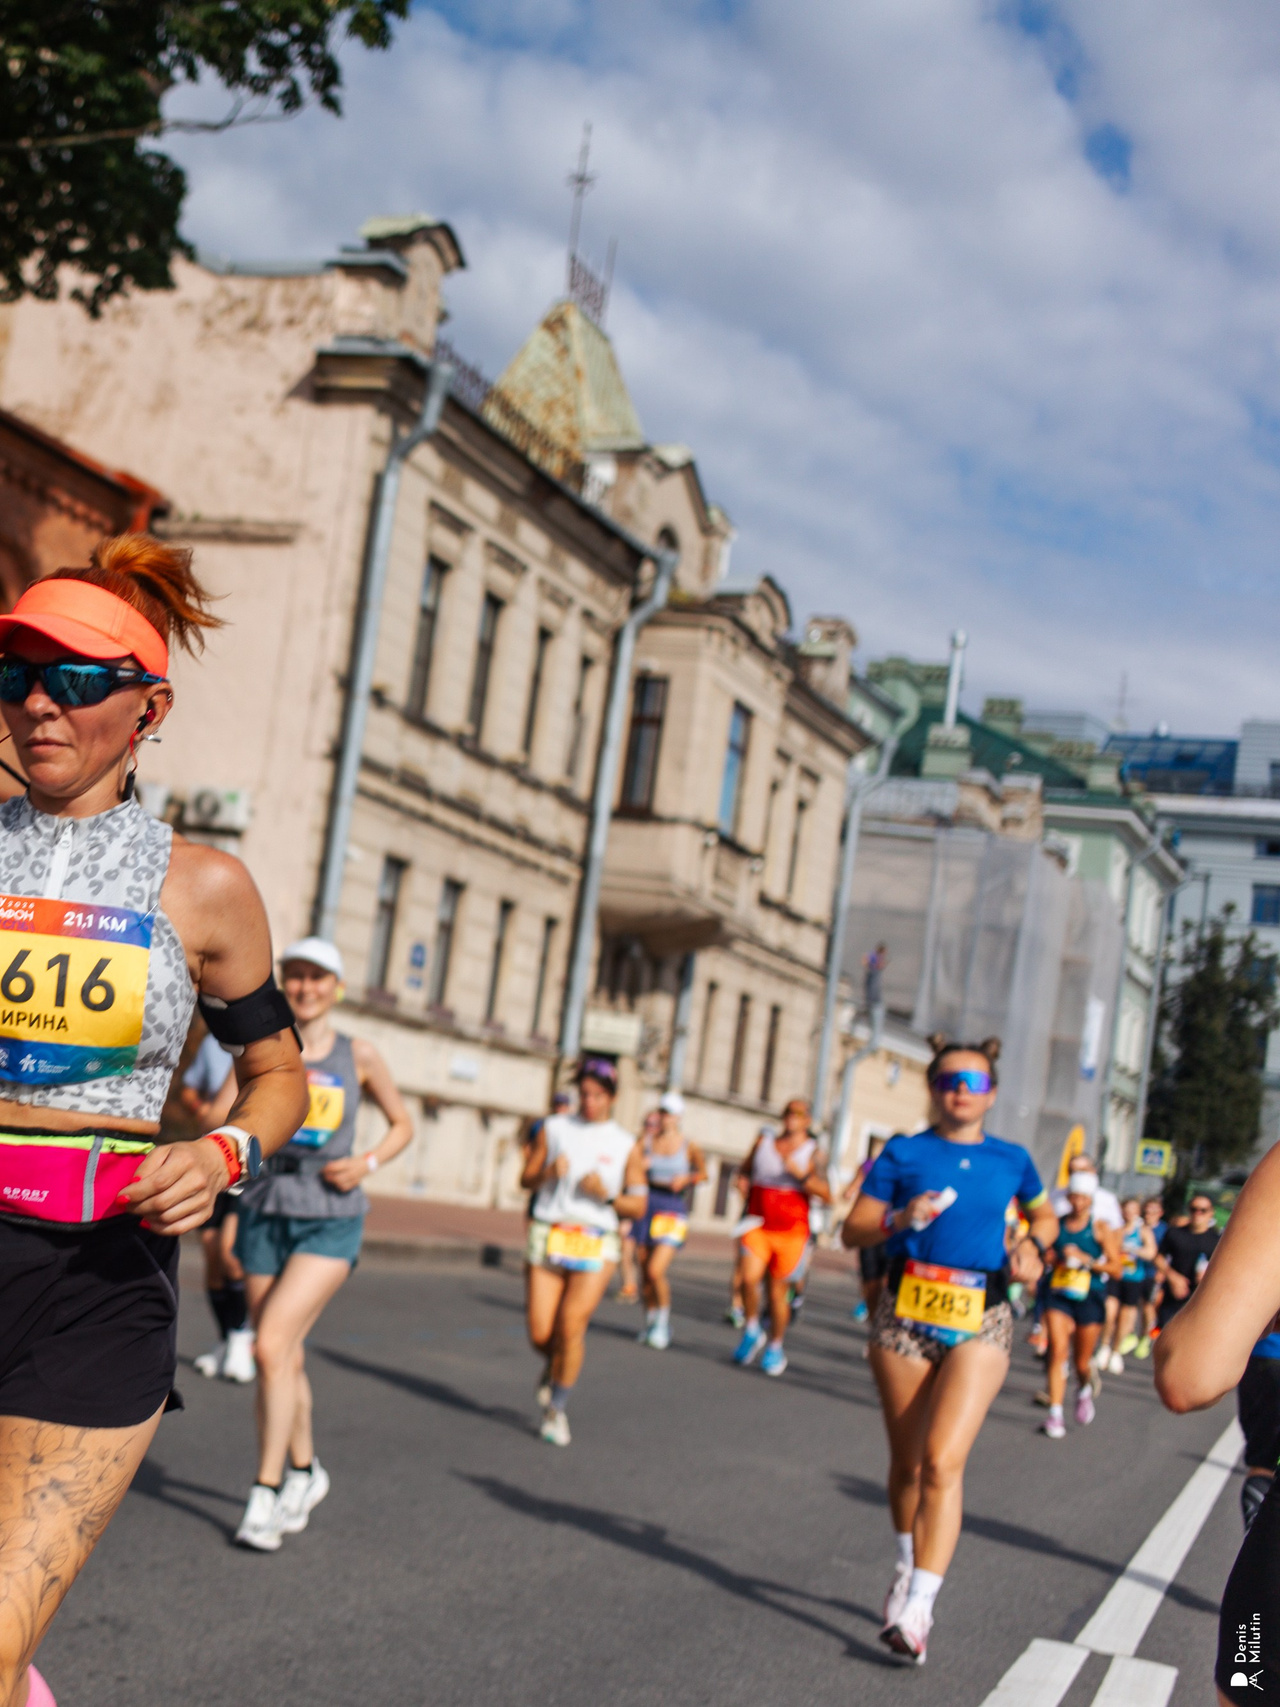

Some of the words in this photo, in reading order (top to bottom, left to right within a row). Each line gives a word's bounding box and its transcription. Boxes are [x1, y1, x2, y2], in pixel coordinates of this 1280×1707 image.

[63, 911, 94, 929] 21,1
[1, 1010, 69, 1032] ИРИНА
[912, 1284, 972, 1317] 1283
